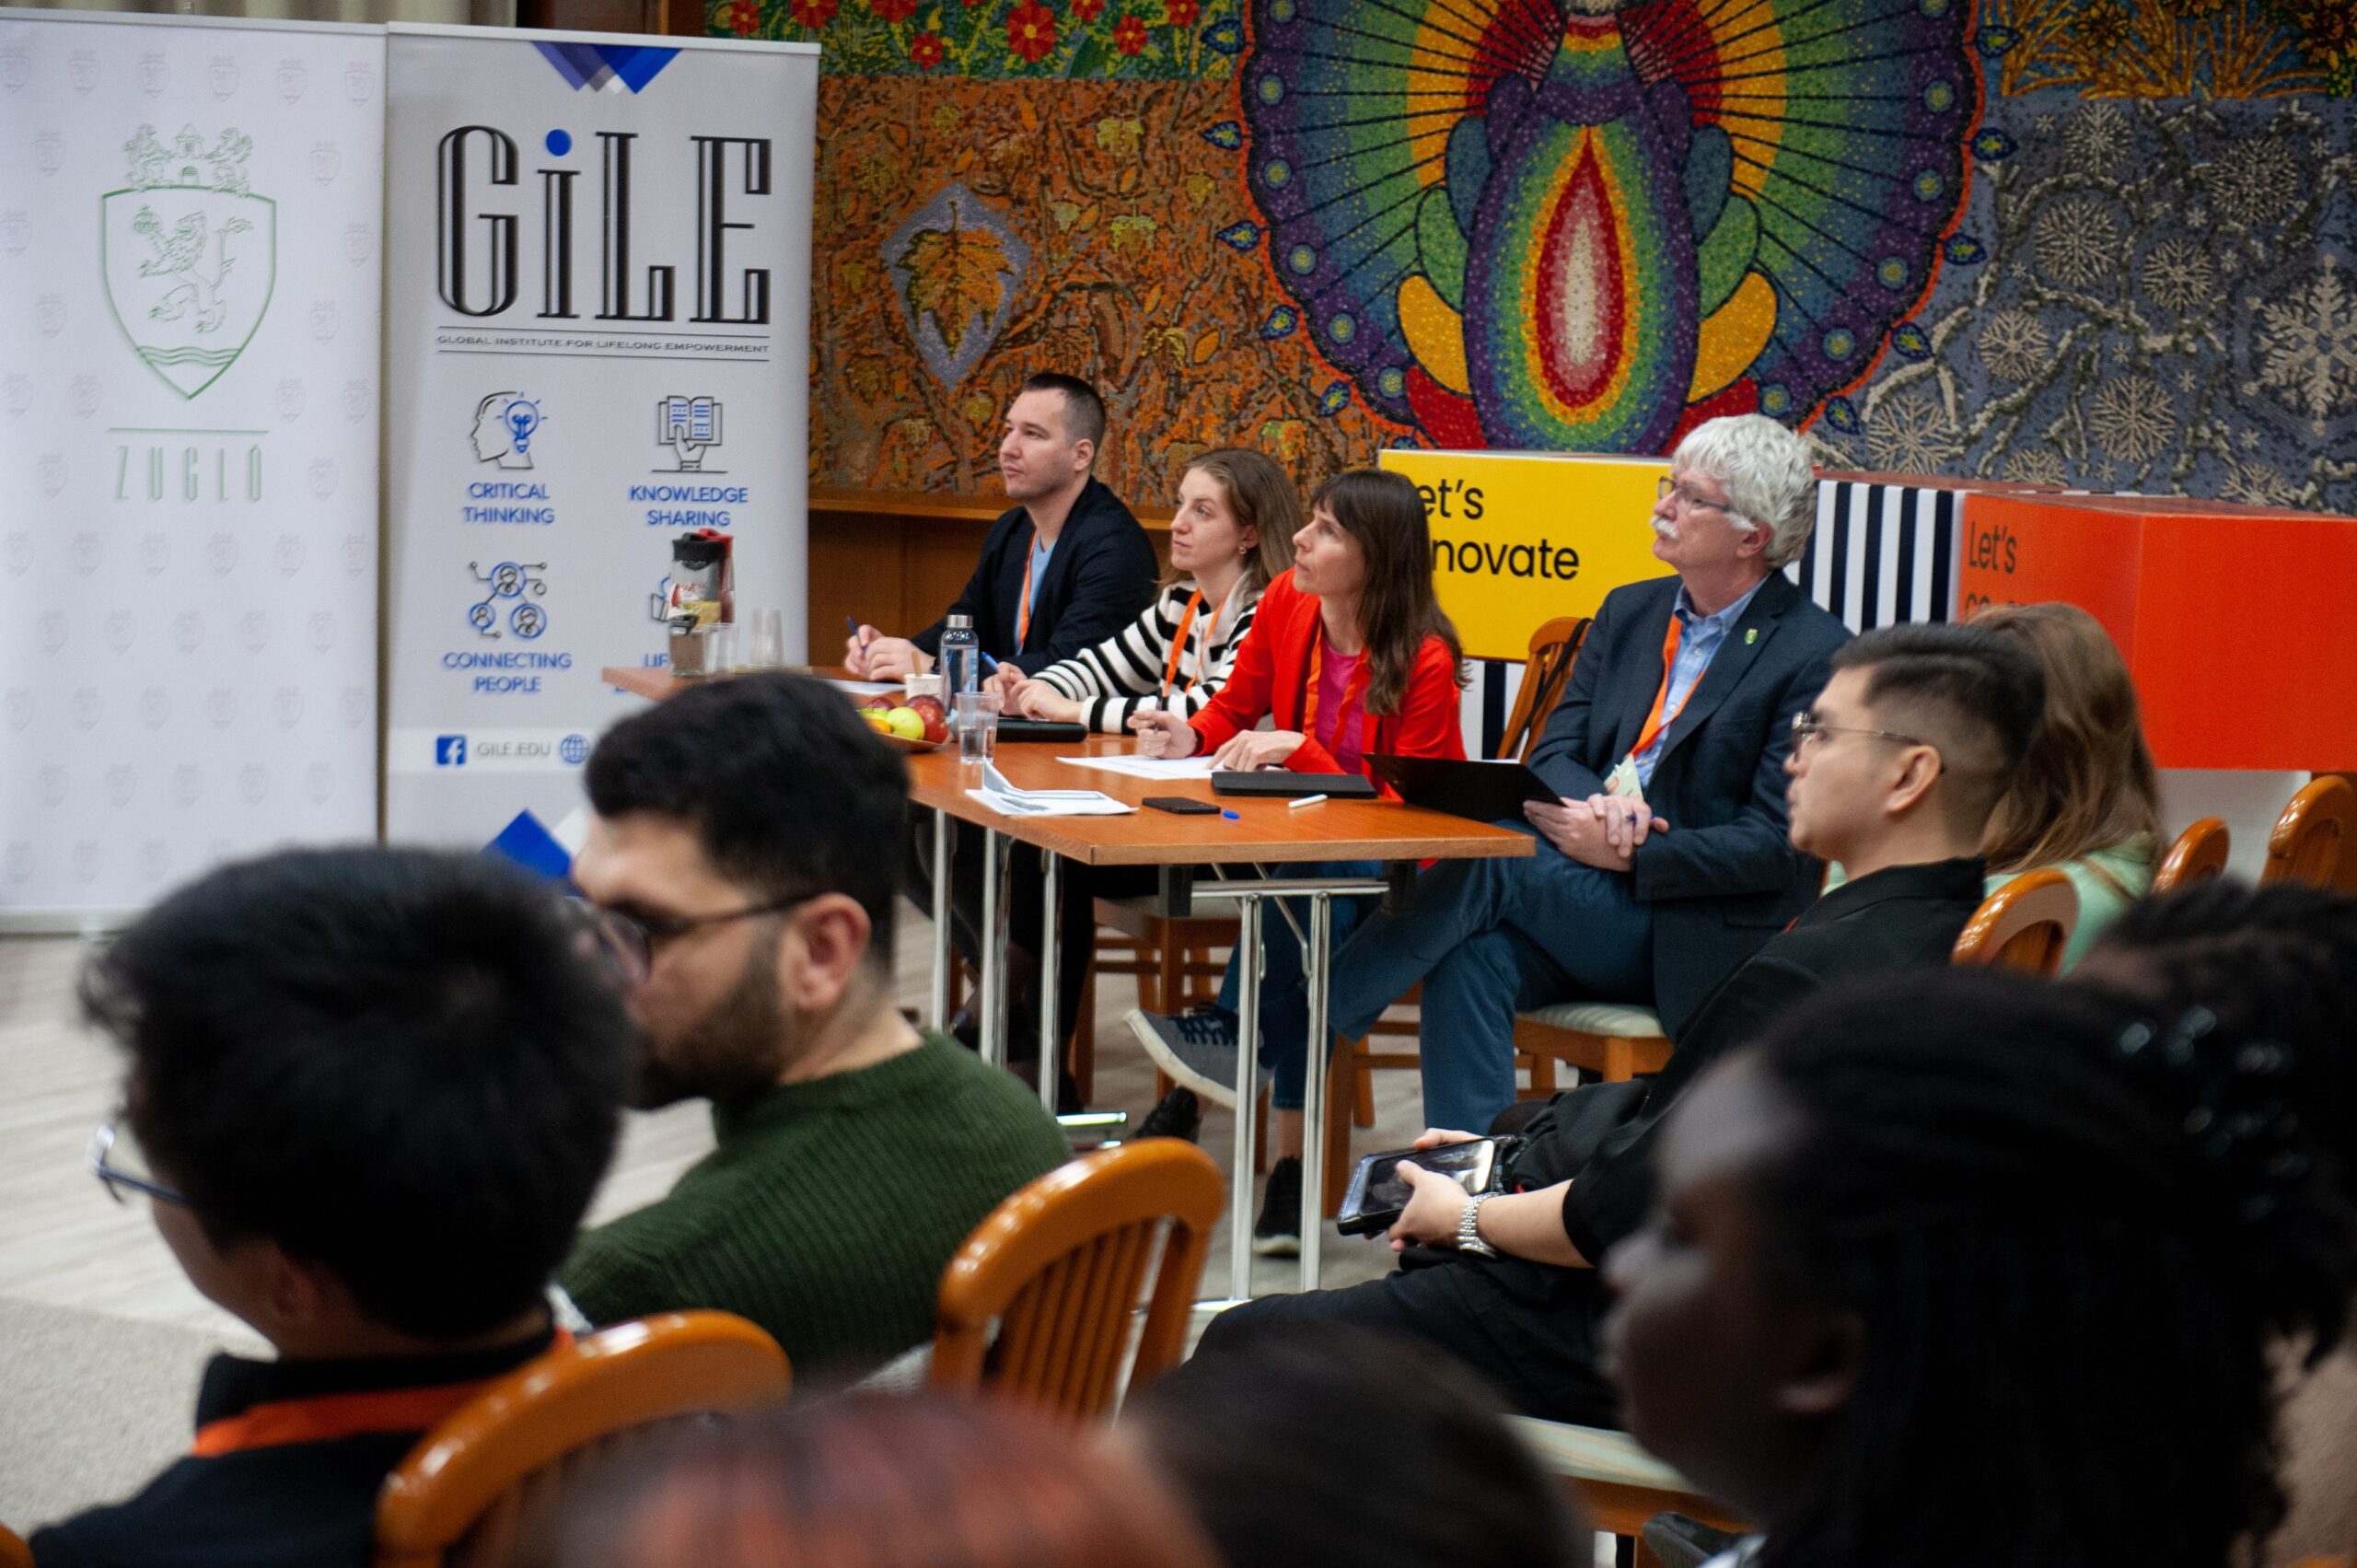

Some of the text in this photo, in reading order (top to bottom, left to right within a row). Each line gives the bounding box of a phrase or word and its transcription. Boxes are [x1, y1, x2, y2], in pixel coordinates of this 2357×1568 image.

[437, 334, 770, 354] GLOBAL INSTITUTE FOR LIFELONG EMPOWERMENT
[469, 482, 550, 500] CRITICAL
[630, 485, 749, 504] KNOWLEDGE
[1414, 479, 1484, 520] et's
[463, 505, 555, 525] THINKING
[647, 509, 731, 528] SHARING
[1969, 520, 2017, 575] Let's
[1432, 539, 1580, 581] novate
[443, 652, 573, 669] CONNECTING
[474, 676, 542, 692] PEOPLE
